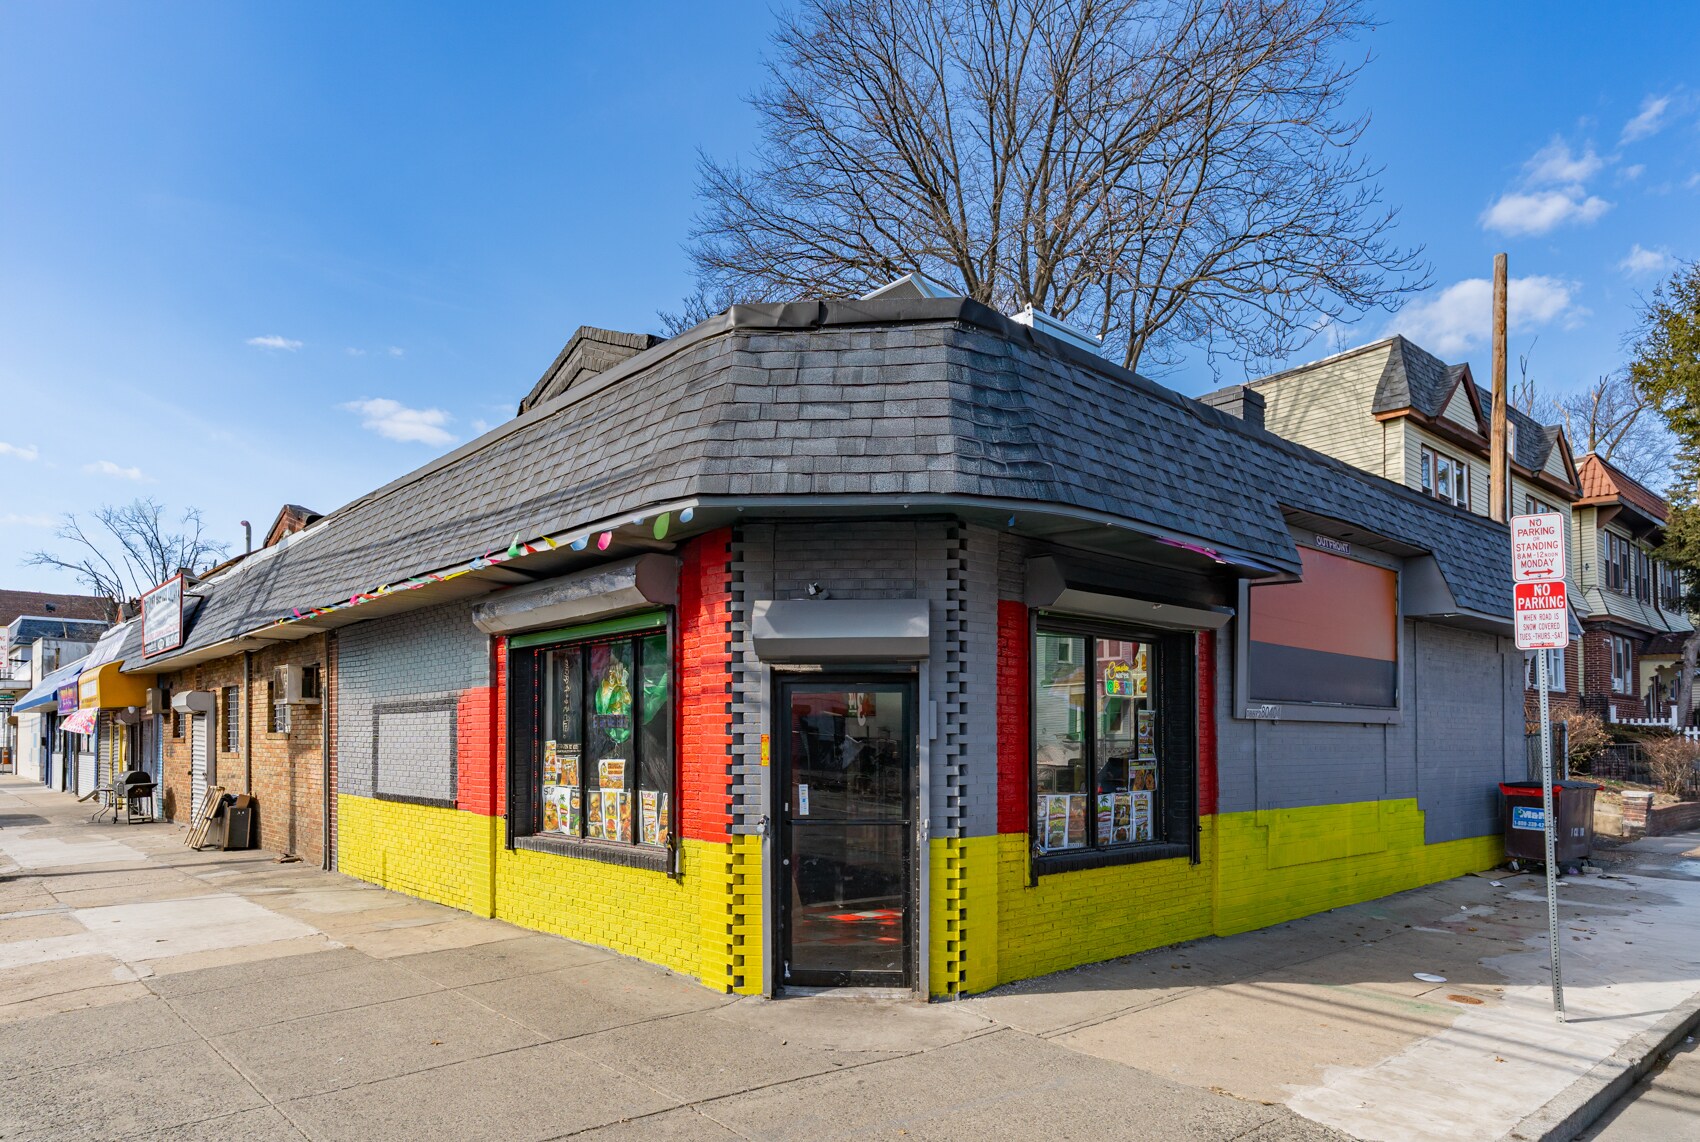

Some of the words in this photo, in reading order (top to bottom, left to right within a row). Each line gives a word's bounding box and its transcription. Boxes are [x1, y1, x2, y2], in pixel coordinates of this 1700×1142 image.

[1529, 519, 1542, 527] NO
[1517, 526, 1555, 537] PARKING
[1316, 536, 1349, 553] OUTFRONT
[1516, 541, 1559, 552] STANDING
[1520, 558, 1554, 569] MONDAY
[1533, 584, 1550, 596] NO
[1518, 596, 1563, 609] PARKING
[1523, 614, 1537, 622] WHEN
[1540, 613, 1552, 621] ROAD
[1523, 622, 1537, 631] SNOW
[1538, 622, 1560, 630] COVERED
[1107, 680, 1132, 694] OPEN
